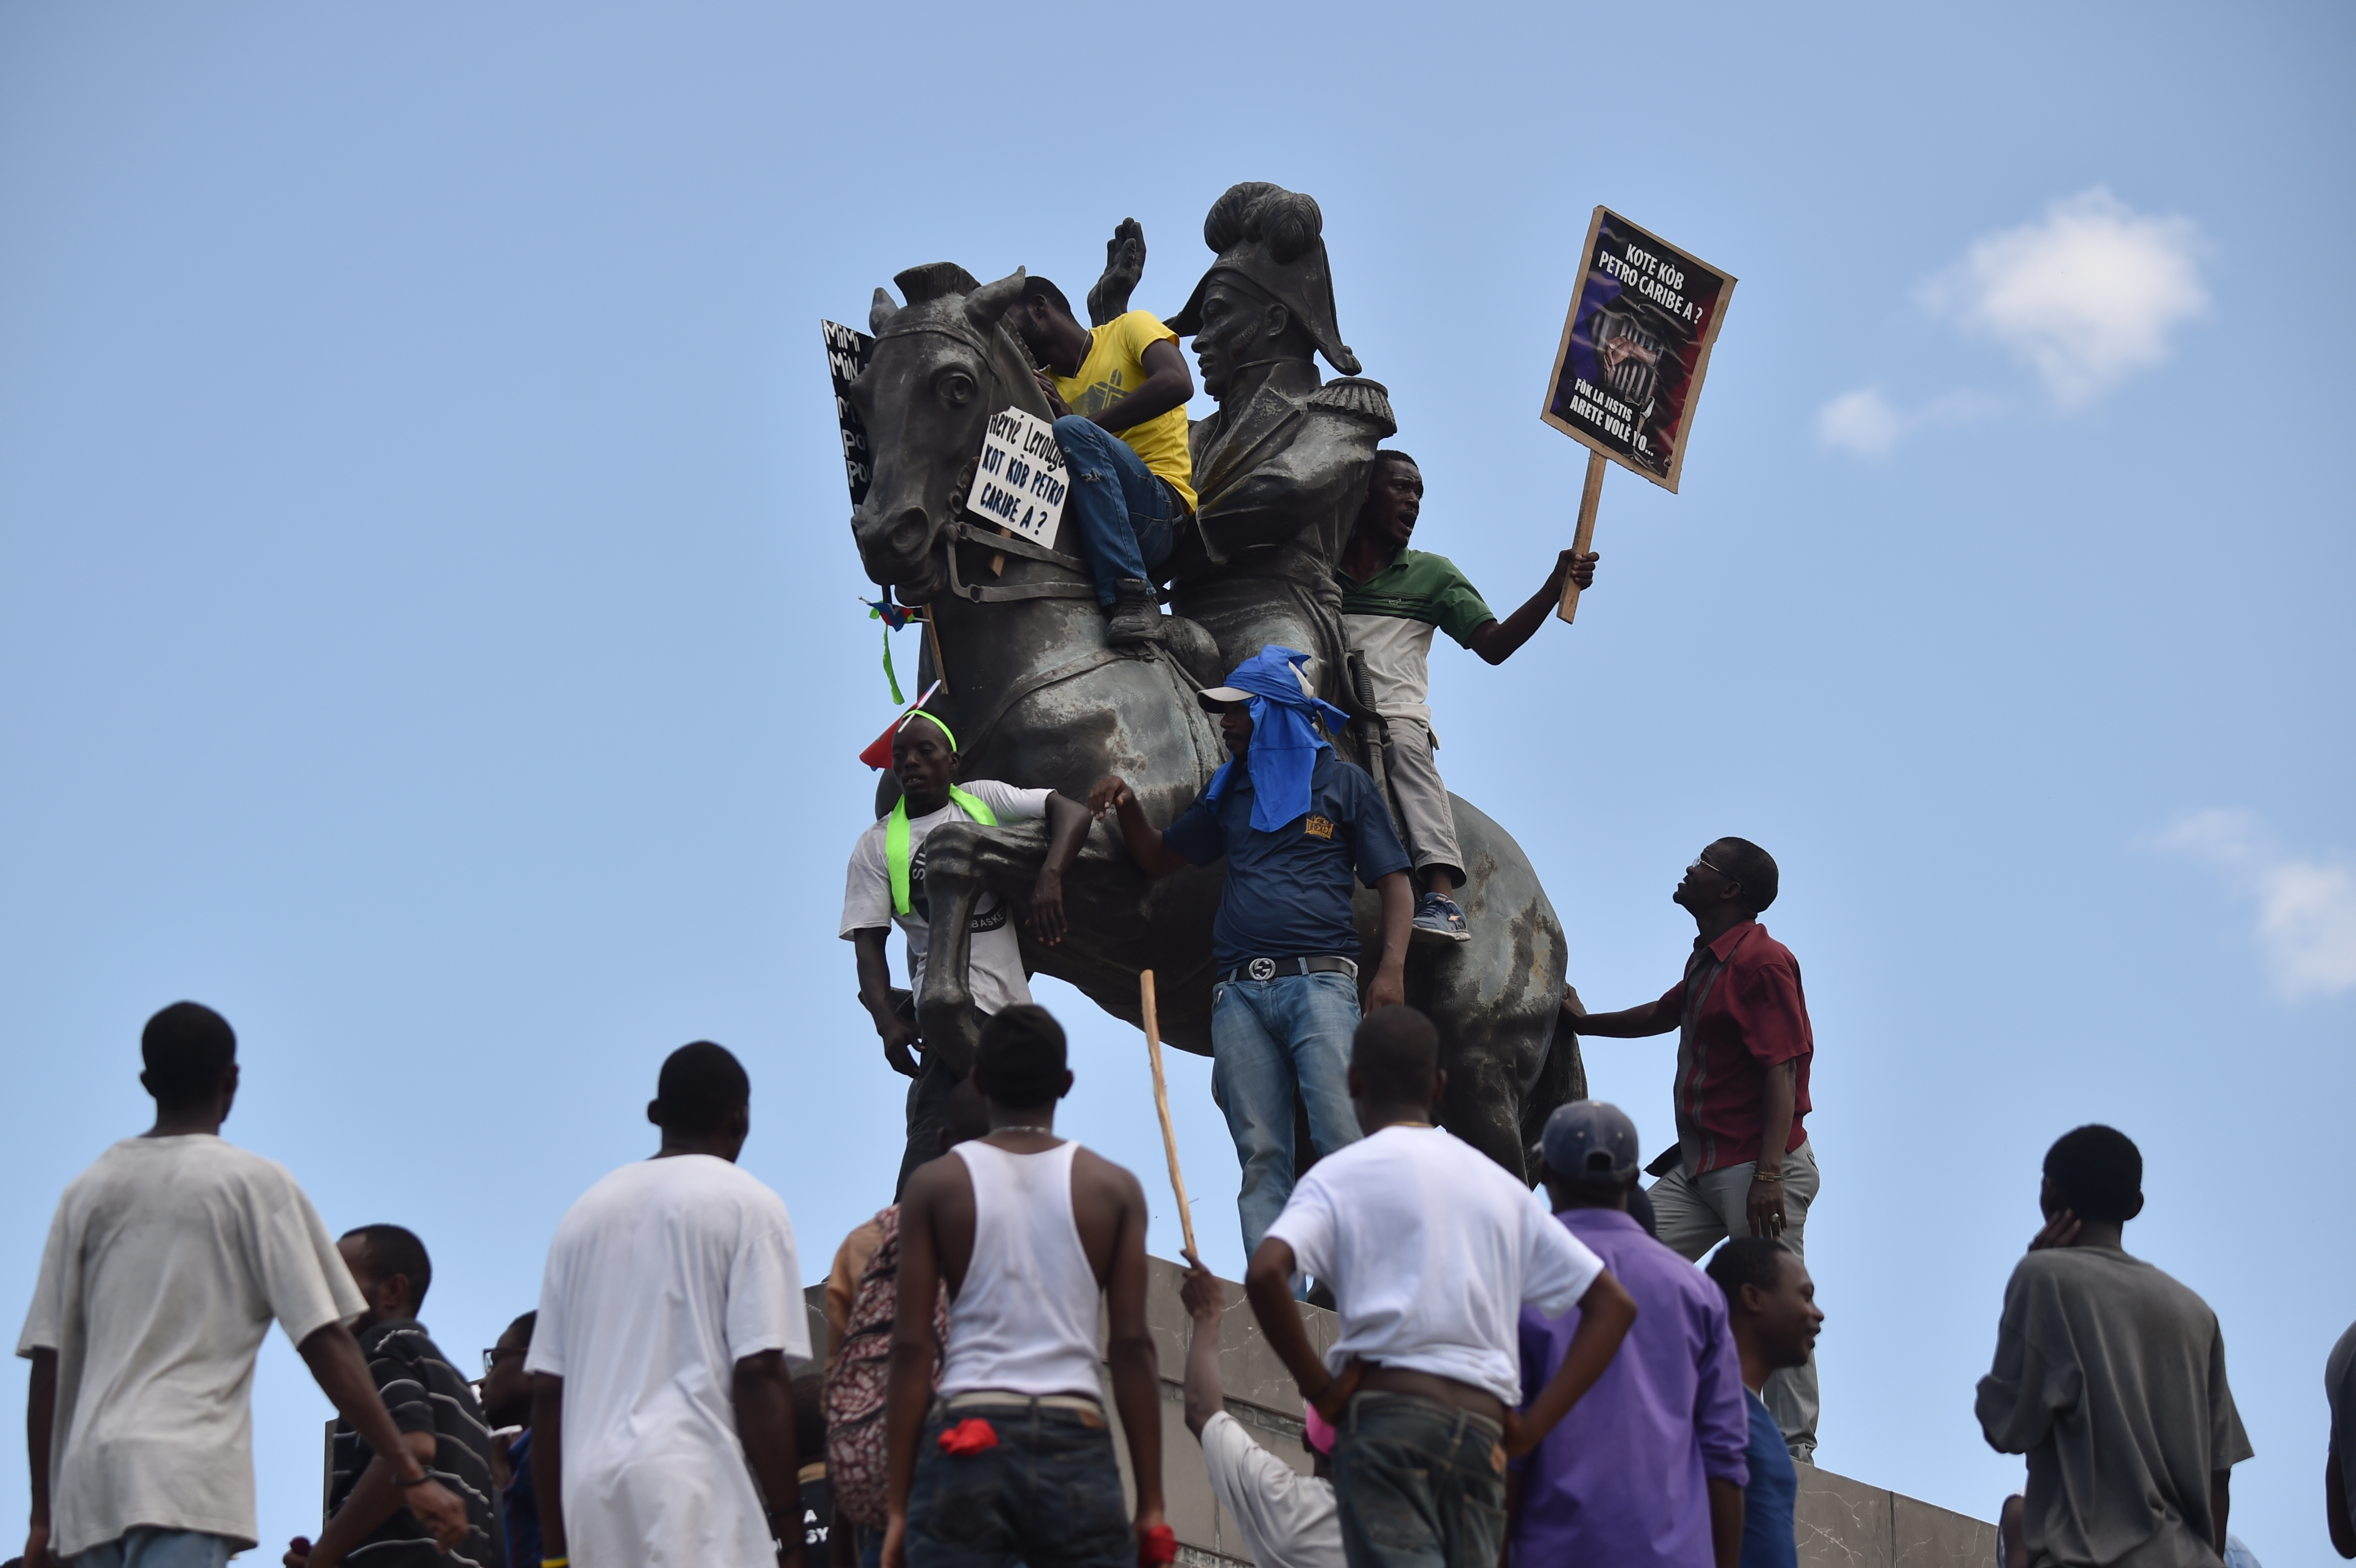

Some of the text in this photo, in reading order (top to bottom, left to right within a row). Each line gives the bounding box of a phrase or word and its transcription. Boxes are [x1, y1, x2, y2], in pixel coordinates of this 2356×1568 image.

[1598, 250, 1703, 324] PETRO CARIBE A ?
[1625, 243, 1684, 290] KOTE KÒB
[1570, 395, 1604, 426] ARETE
[1604, 414, 1632, 443] VOLÈ
[1574, 378, 1633, 422] FÒK LA JISTIS
[982, 444, 1065, 507] KOT KÒB PETRO
[980, 482, 1048, 535] CARIBE A ?
